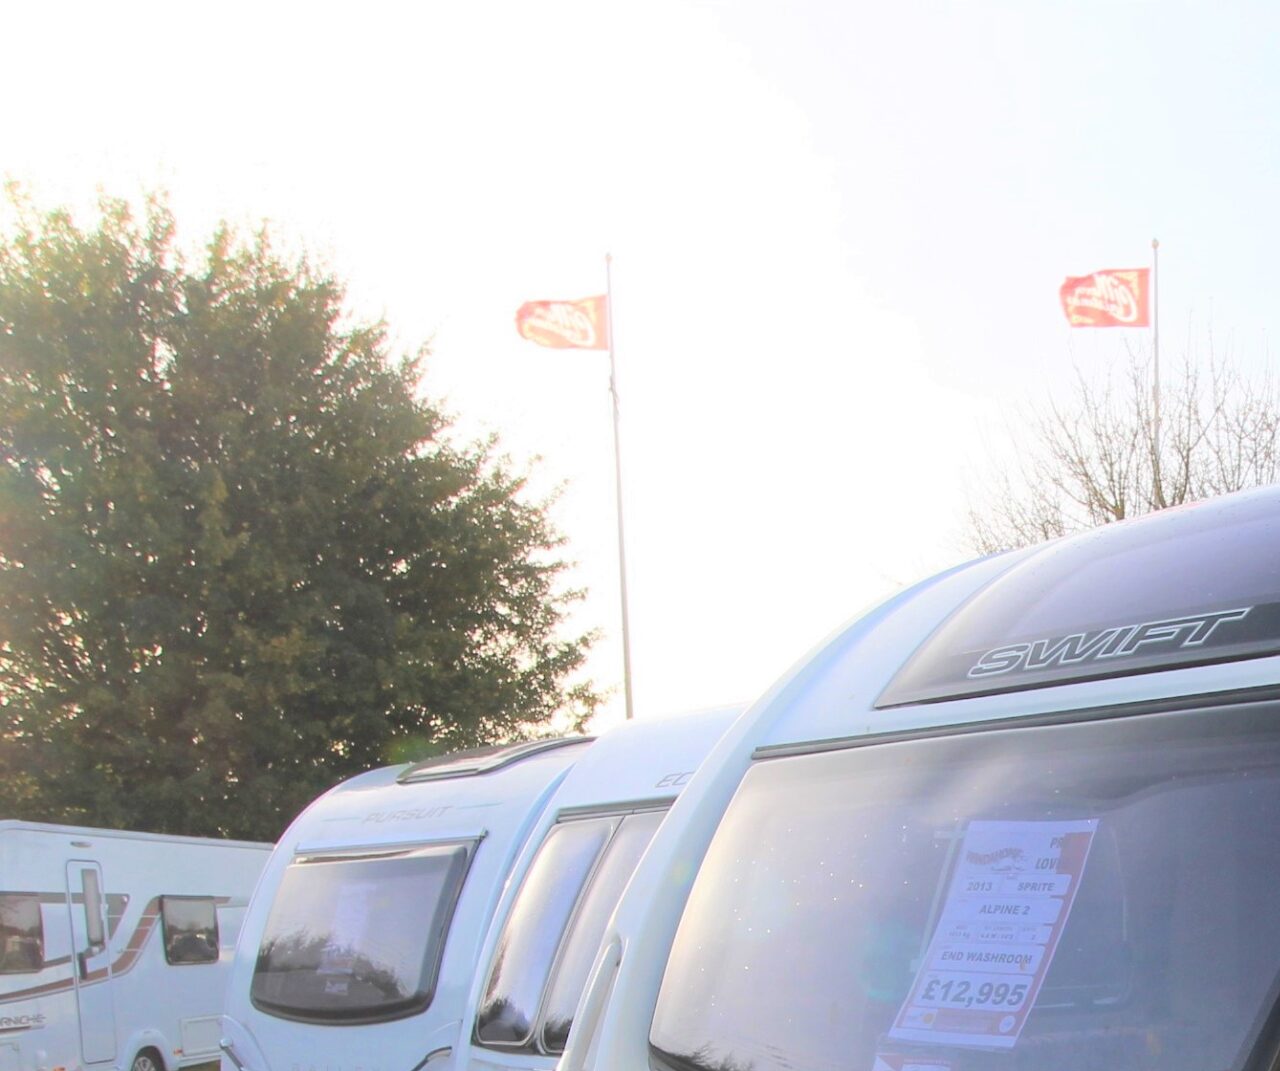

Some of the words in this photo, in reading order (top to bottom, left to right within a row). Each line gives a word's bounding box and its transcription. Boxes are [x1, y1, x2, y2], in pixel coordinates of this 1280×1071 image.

[967, 606, 1253, 679] SWIFT
[362, 805, 454, 824] PURSUIT
[966, 881, 993, 892] 2013
[1016, 882, 1056, 892] SPRITE
[979, 904, 1020, 915] ALPINE
[1022, 905, 1031, 916] 2
[941, 951, 963, 961] END
[965, 952, 1033, 965] WASHROOM
[922, 979, 1028, 1008] £12,995
